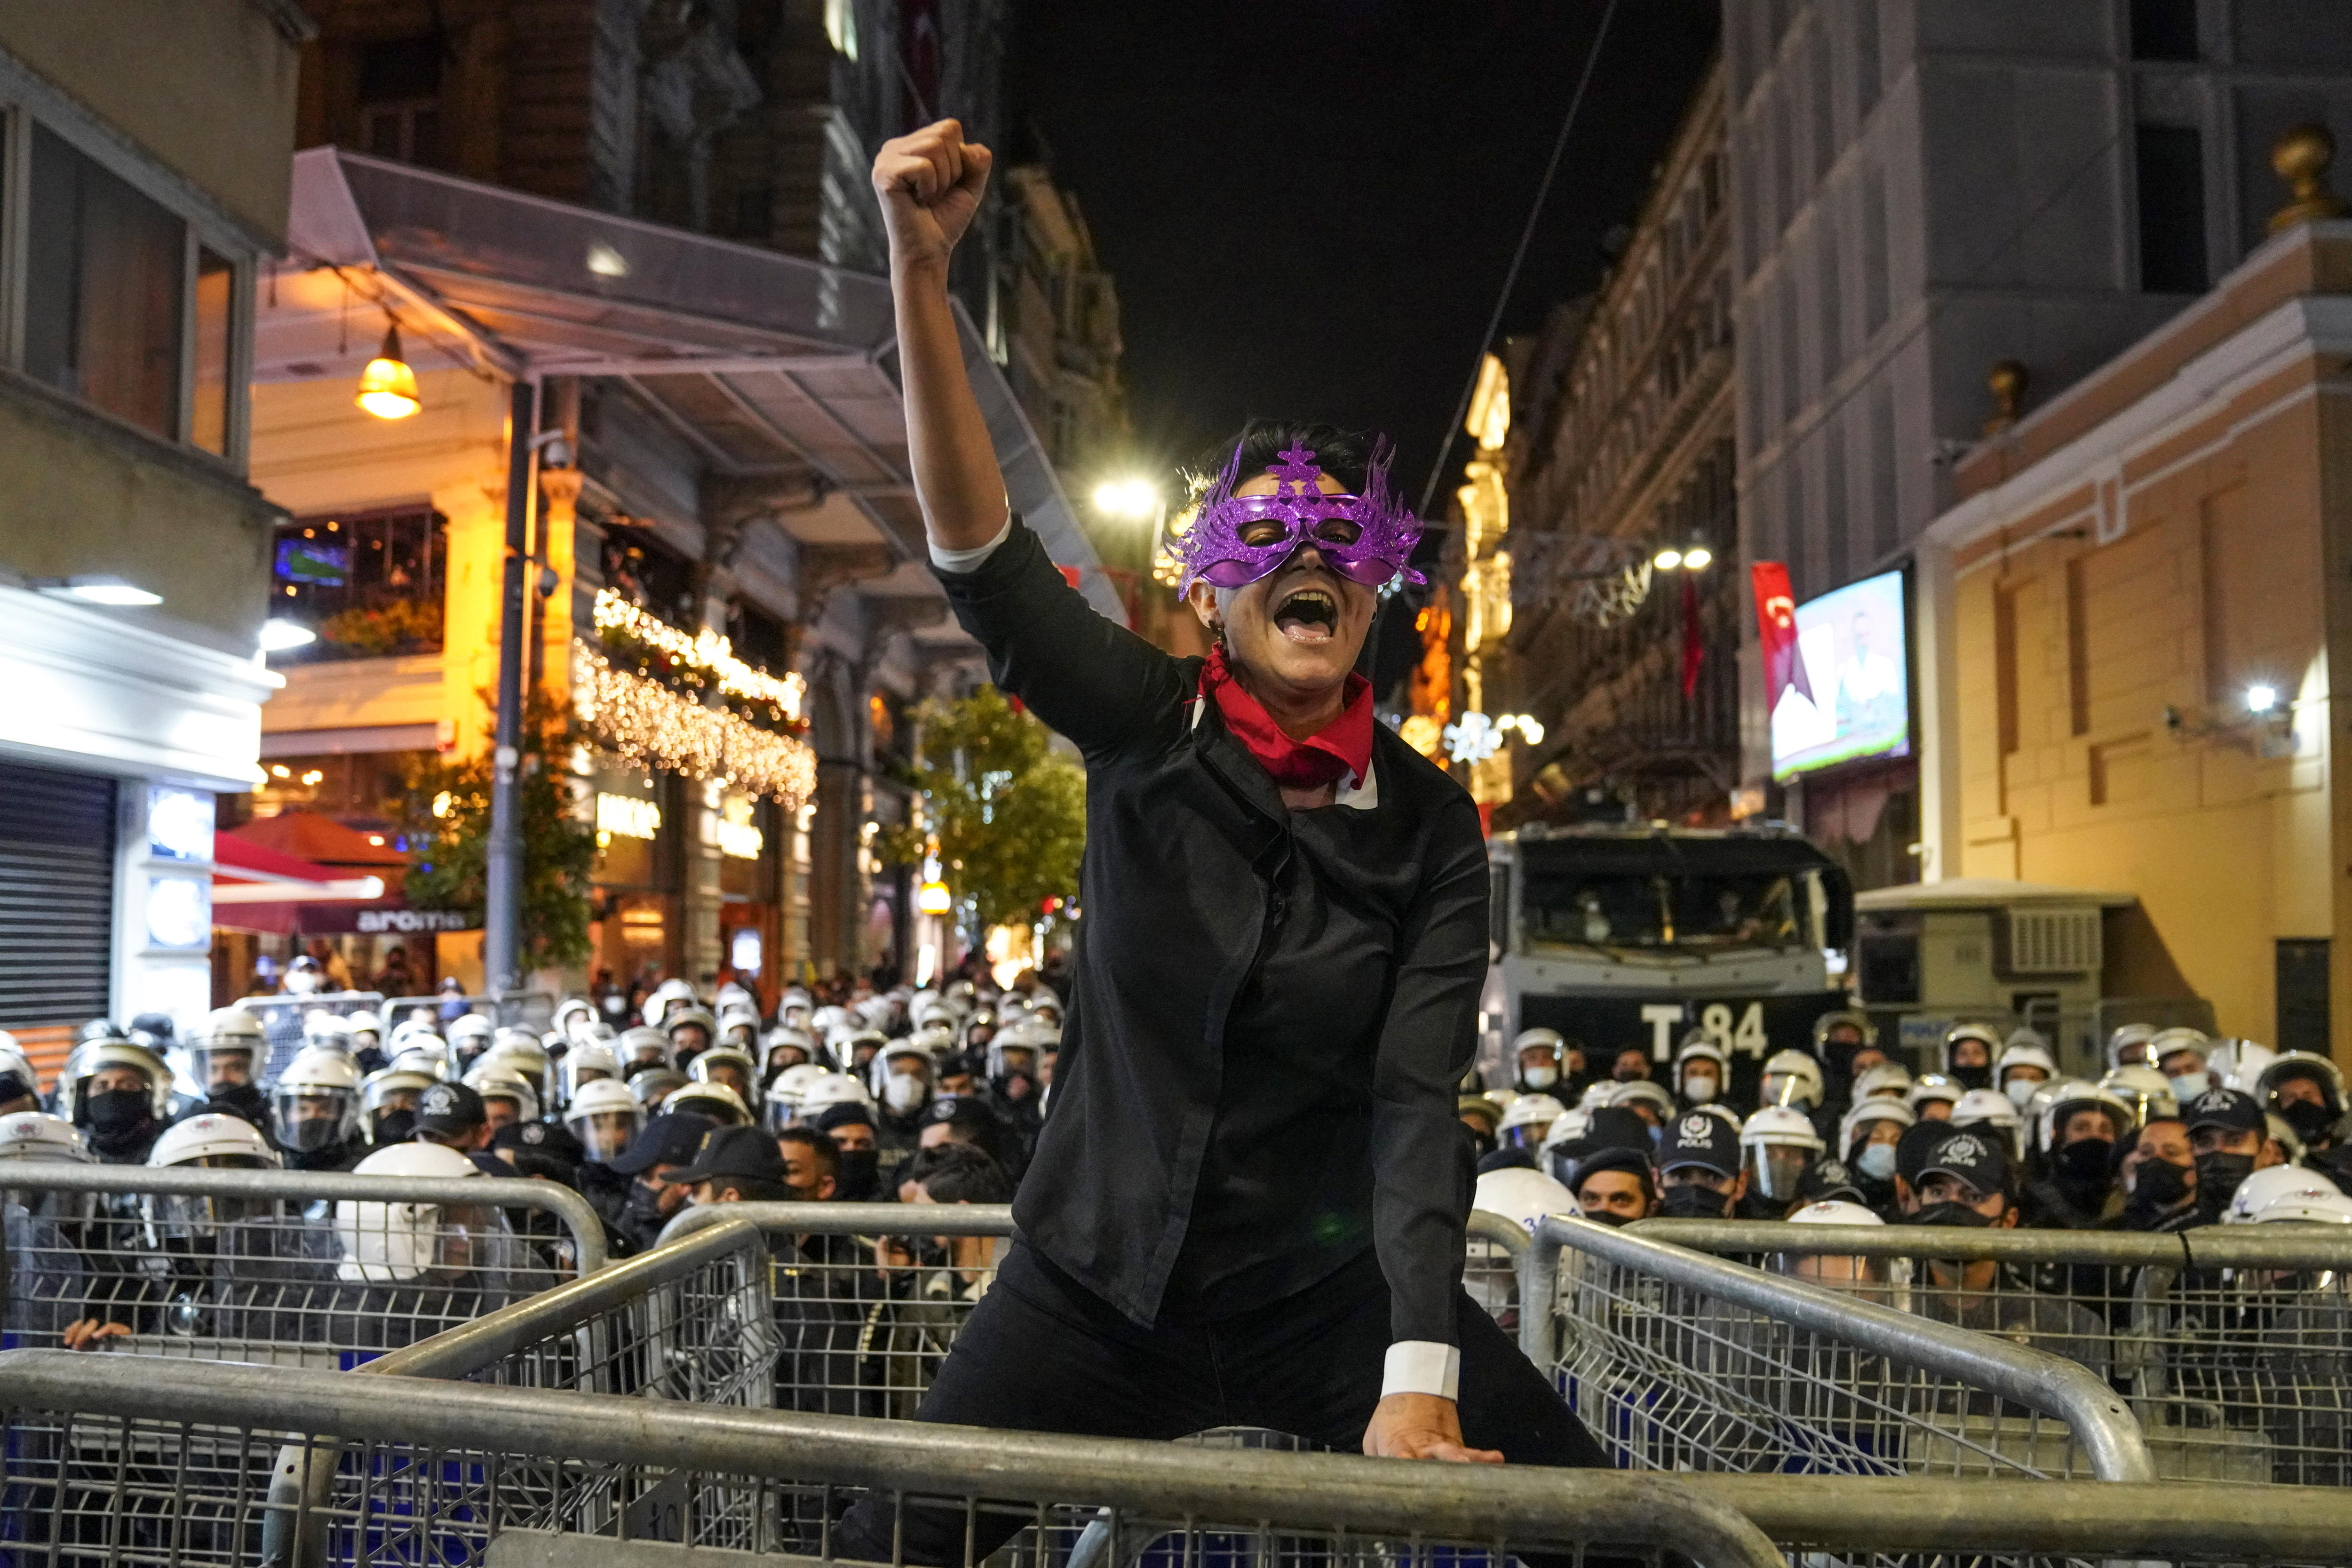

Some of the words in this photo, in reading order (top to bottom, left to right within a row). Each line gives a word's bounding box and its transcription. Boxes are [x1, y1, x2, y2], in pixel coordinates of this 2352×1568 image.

[357, 910, 466, 932] aroma
[1641, 1004, 1684, 1063] T
[1702, 1001, 1769, 1061] 84
